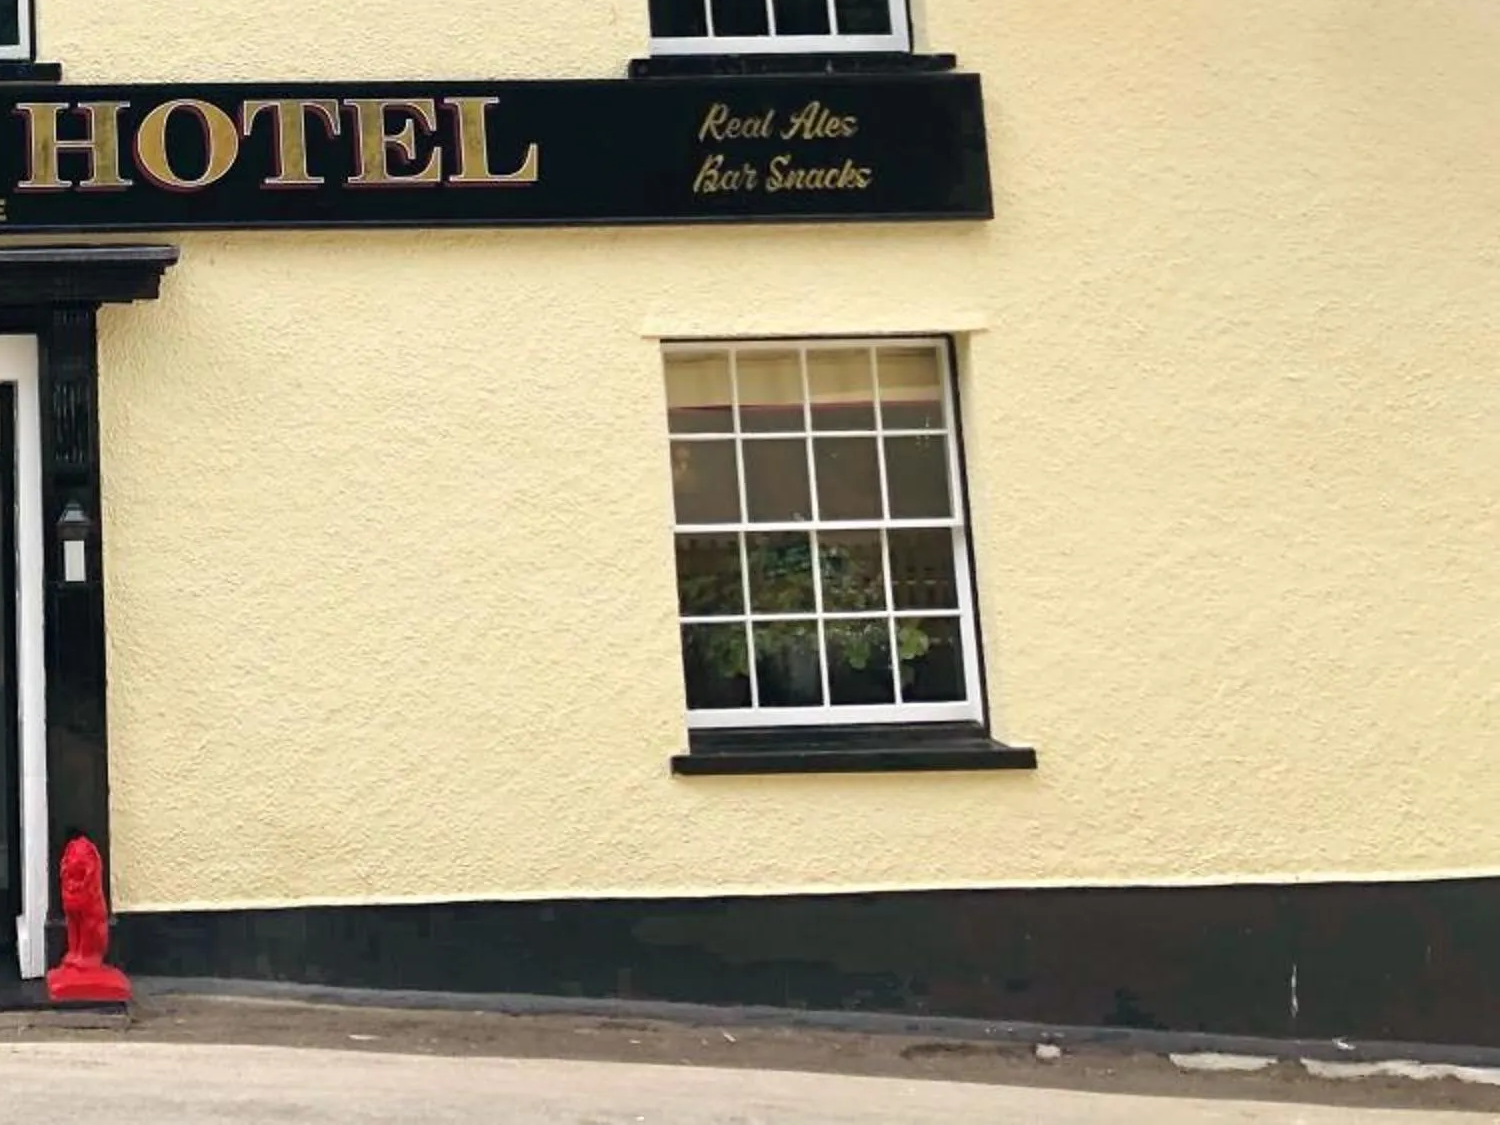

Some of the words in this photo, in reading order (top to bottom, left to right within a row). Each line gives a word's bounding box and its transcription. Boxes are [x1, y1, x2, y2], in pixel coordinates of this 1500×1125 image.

[699, 102, 775, 142] Real
[780, 100, 859, 140] Ales
[13, 96, 539, 194] HOTEL
[693, 154, 758, 193] Bar
[765, 154, 872, 193] Snacks
